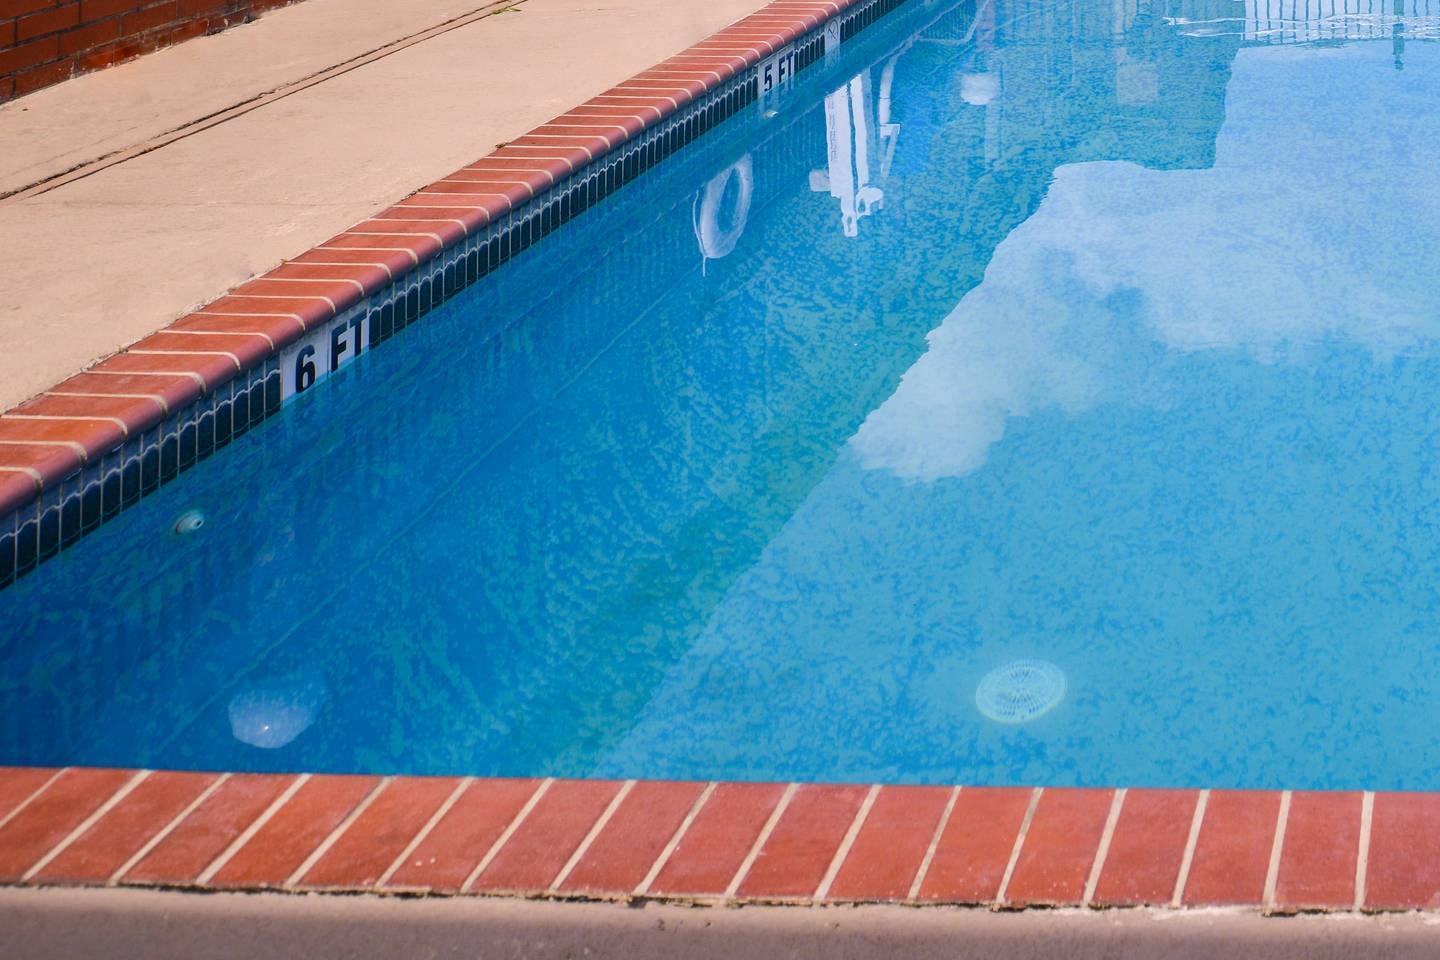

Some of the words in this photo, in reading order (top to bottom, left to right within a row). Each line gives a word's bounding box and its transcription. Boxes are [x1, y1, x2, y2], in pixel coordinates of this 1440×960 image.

[764, 63, 773, 92] 5
[779, 50, 793, 83] FT
[295, 344, 316, 394] 6
[331, 308, 367, 373] FT
